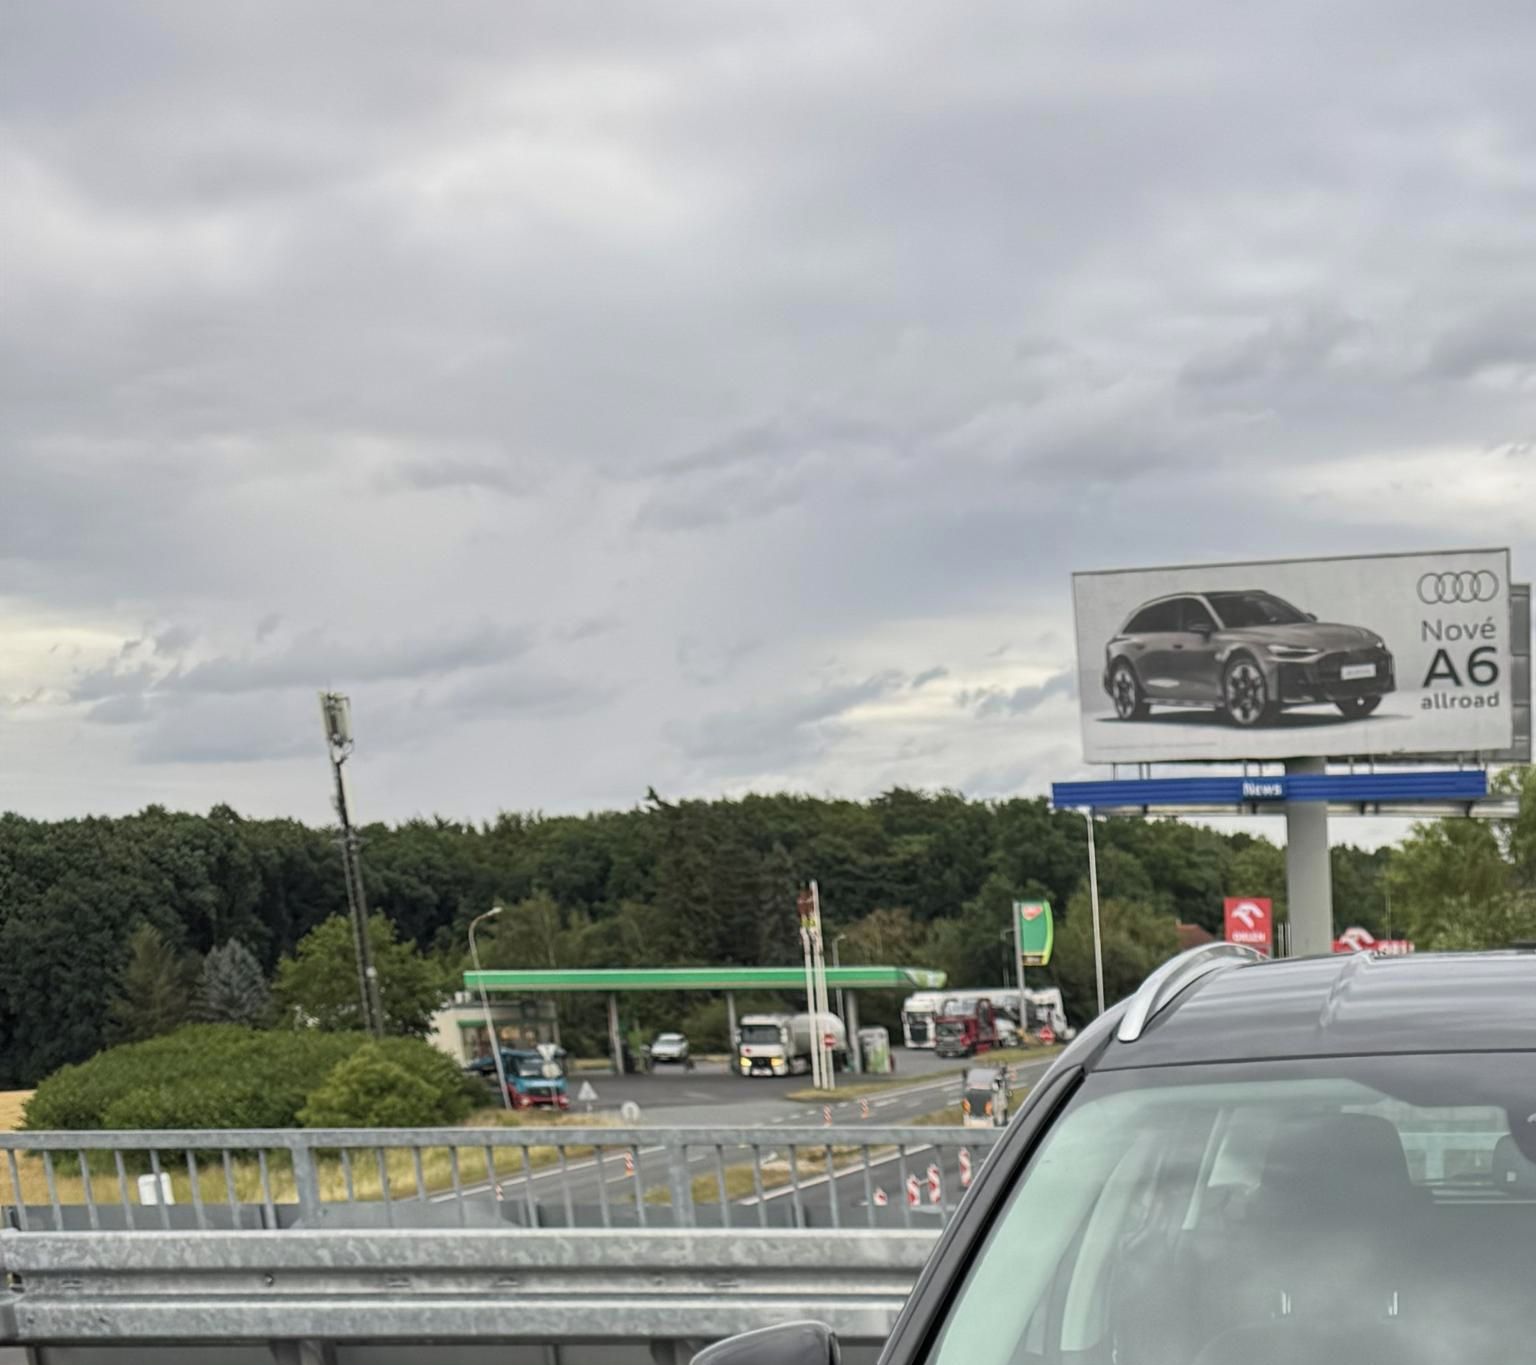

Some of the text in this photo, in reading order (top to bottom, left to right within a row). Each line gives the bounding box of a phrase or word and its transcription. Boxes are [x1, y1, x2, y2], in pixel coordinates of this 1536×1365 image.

[1421, 616, 1496, 641] Nové
[1422, 645, 1499, 688] A6
[1421, 691, 1500, 710] allroad
